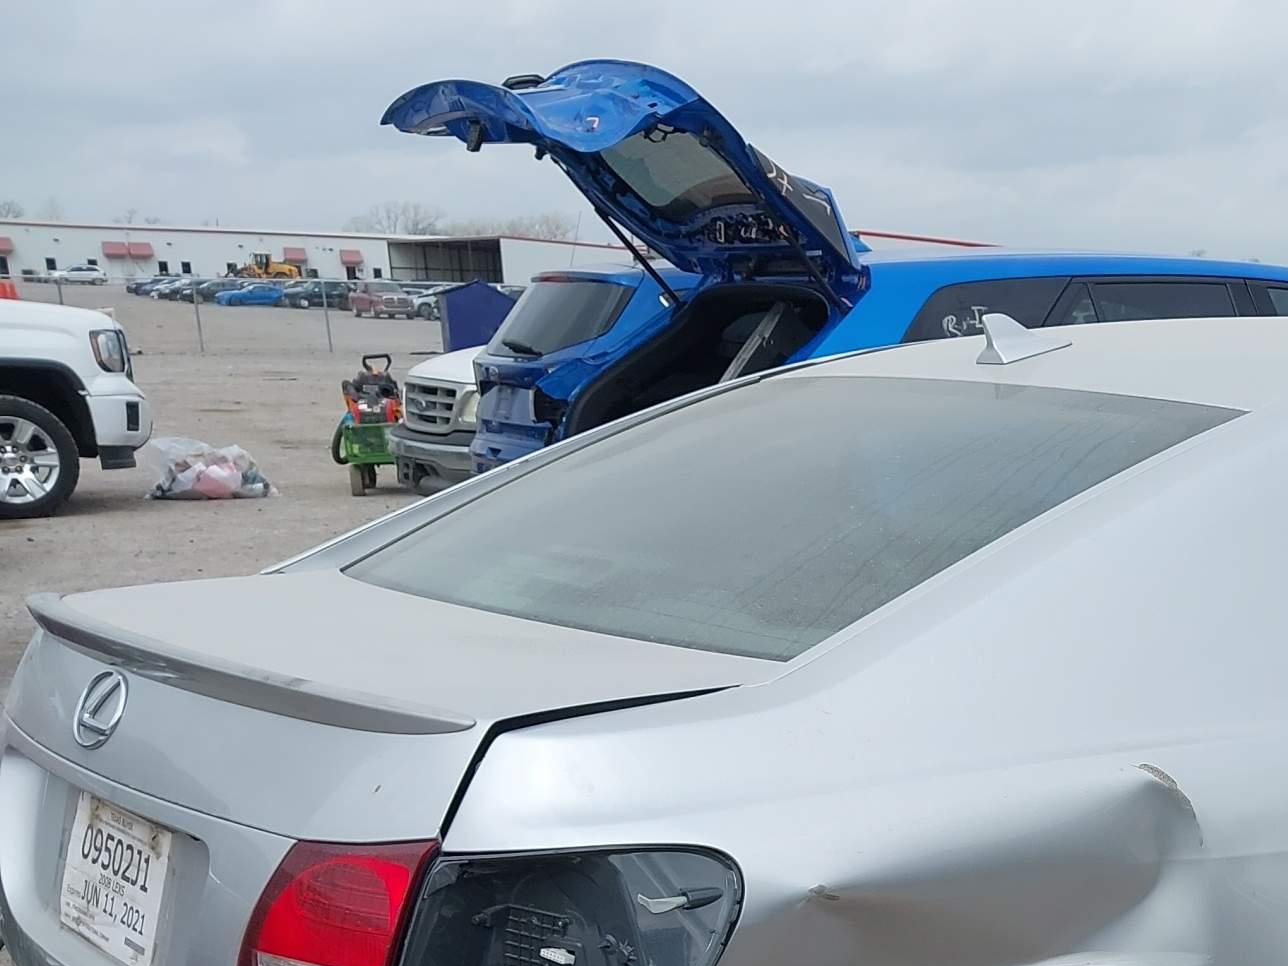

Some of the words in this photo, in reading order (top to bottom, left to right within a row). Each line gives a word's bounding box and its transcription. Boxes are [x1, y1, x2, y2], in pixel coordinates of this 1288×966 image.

[81, 823, 151, 893] 09502J1
[81, 880, 101, 908] JUN
[103, 893, 117, 924] 11,
[120, 902, 146, 936] 2021
